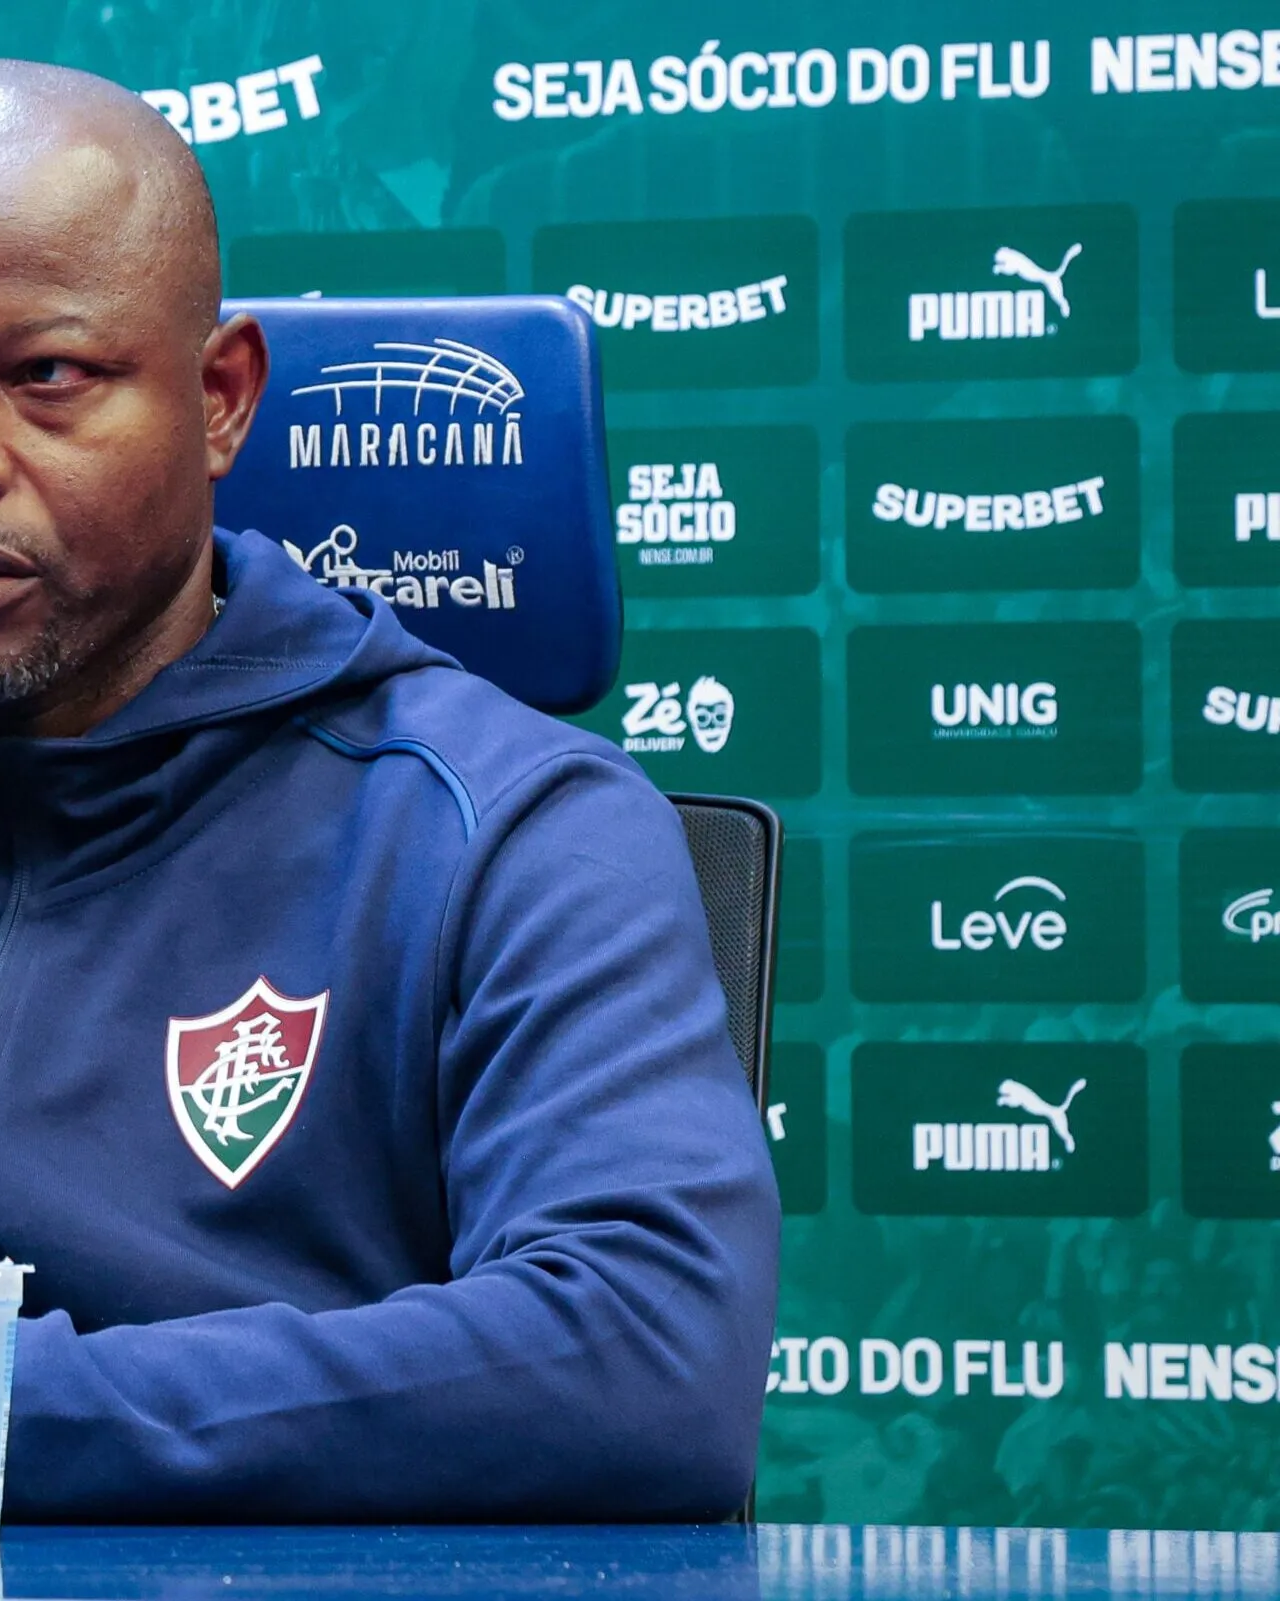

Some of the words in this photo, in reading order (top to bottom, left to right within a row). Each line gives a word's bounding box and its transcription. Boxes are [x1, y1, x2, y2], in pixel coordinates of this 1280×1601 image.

[142, 55, 323, 144] RBET
[494, 60, 644, 121] SEJA
[649, 40, 837, 114] SÓCIO
[848, 44, 930, 103] DO
[941, 40, 1050, 99] FLU
[565, 276, 787, 332] SUPERBET
[910, 290, 1045, 341] PUMA
[290, 412, 524, 468] MARACANÃ
[628, 463, 723, 500] SEJA
[873, 476, 1105, 532] SUPERBET
[617, 499, 736, 544] SÓCIO
[639, 547, 713, 564] NENSE.COM.BR
[623, 682, 686, 735] Zé
[932, 682, 1057, 726] UNIG
[623, 737, 685, 752] DELIVERY
[932, 901, 1067, 950] Leve
[914, 1123, 1050, 1171] PUMA
[860, 1337, 943, 1396] DO
[954, 1340, 1064, 1398] FLU
[1105, 1342, 1280, 1403] NENS
